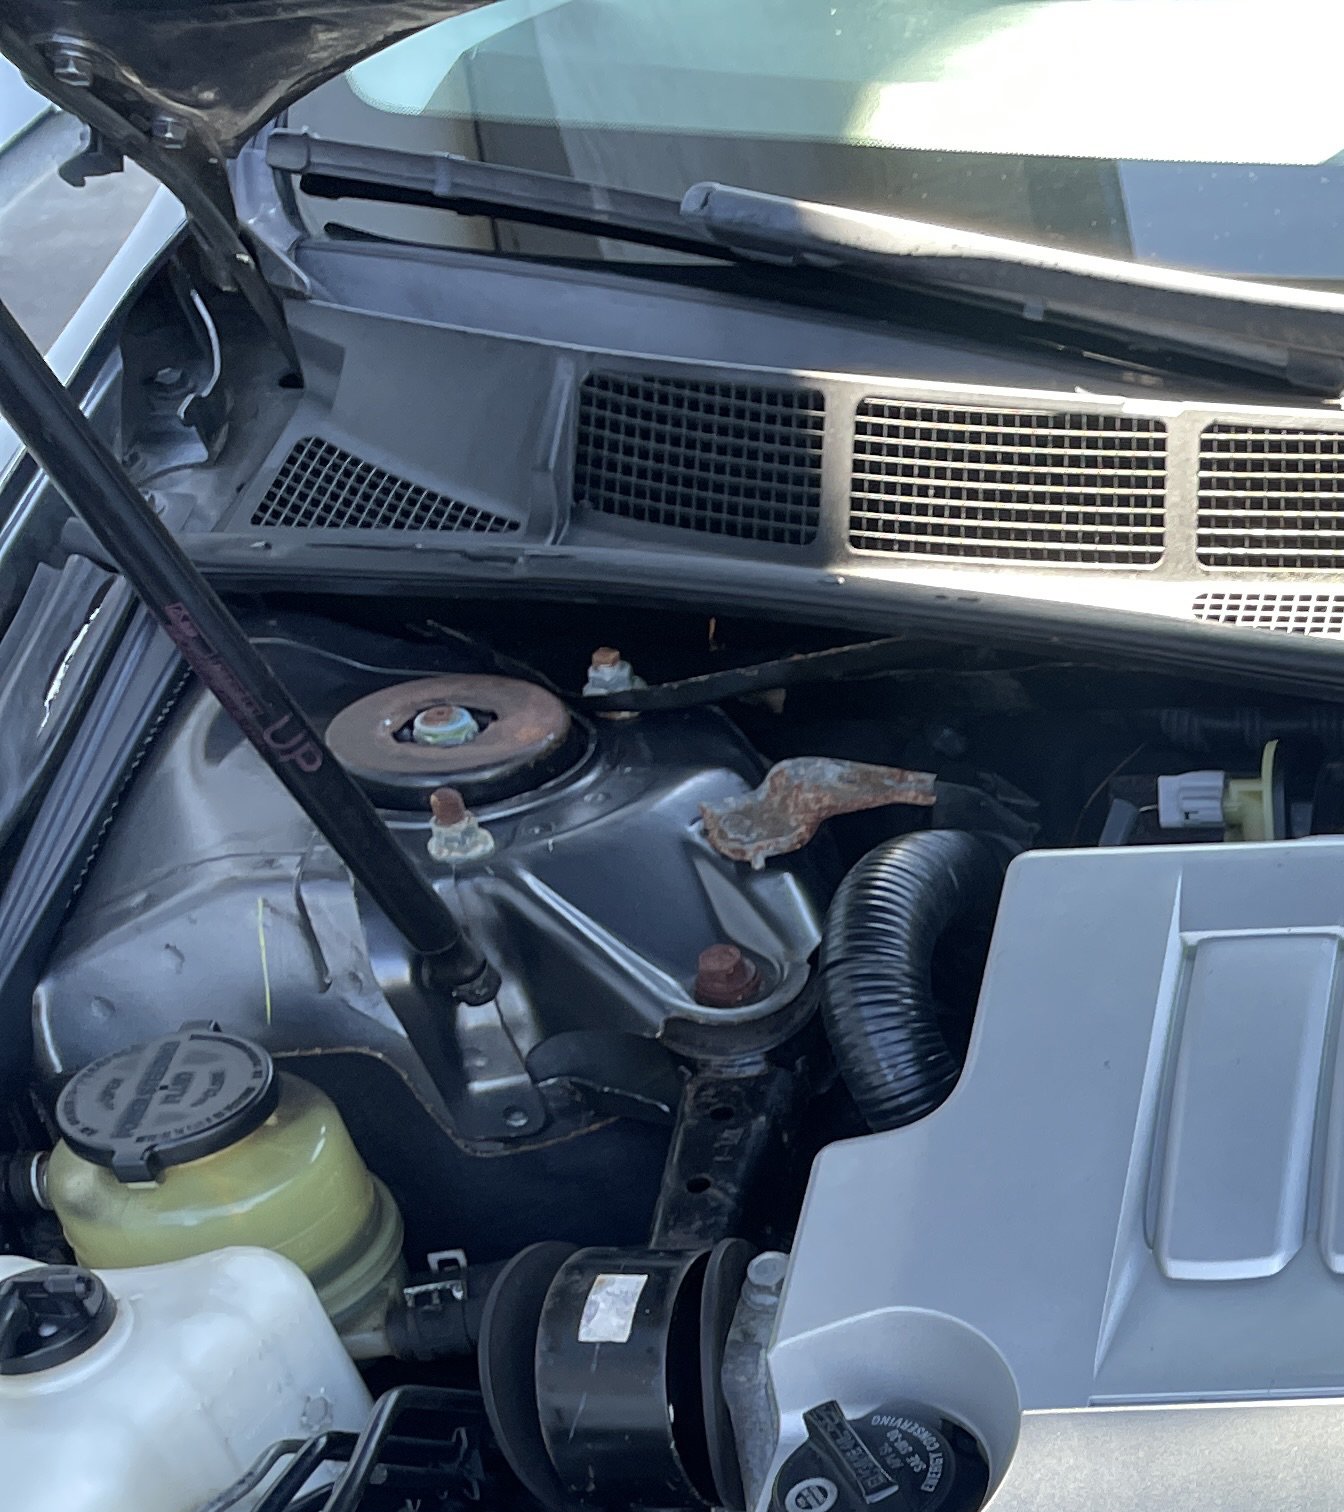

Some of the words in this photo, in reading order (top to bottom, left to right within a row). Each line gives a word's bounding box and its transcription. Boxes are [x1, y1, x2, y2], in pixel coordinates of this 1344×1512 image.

[871, 1415, 940, 1451] CONSERVING
[906, 1453, 927, 1473] SAE
[921, 1452, 944, 1493] ENERGY
